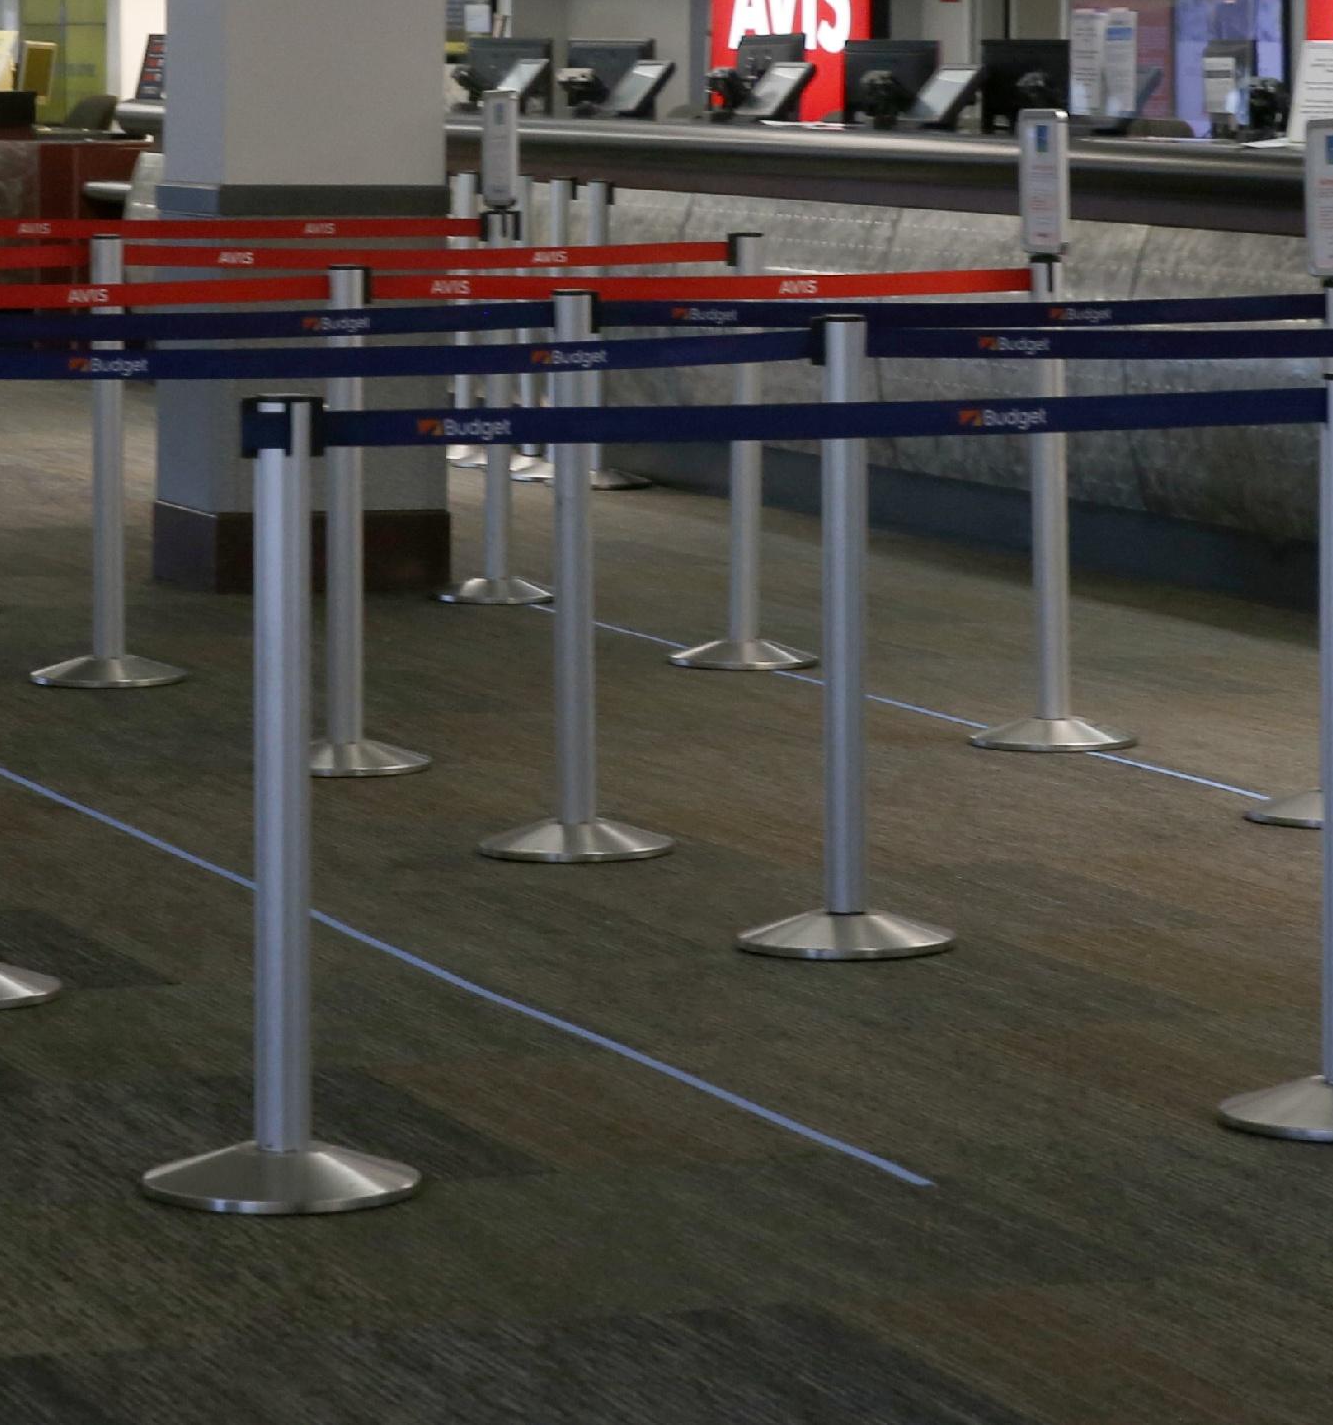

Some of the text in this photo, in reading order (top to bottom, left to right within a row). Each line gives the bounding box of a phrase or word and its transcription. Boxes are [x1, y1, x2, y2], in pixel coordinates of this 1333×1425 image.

[18, 223, 51, 234] AVIS
[304, 223, 336, 235] AVIS
[218, 251, 254, 265] AVIS
[532, 250, 567, 263] AVIS
[431, 281, 469, 294] AVIS
[779, 280, 817, 294] AVIS
[68, 289, 108, 303] AVIS
[690, 307, 737, 323] Budget
[1064, 307, 1112, 322] Budget
[321, 317, 370, 331] Budget
[998, 337, 1050, 352] Budget
[552, 348, 607, 366] Budget
[90, 358, 147, 376] Budget
[982, 408, 1047, 428] Budget
[444, 418, 511, 437] Budget
